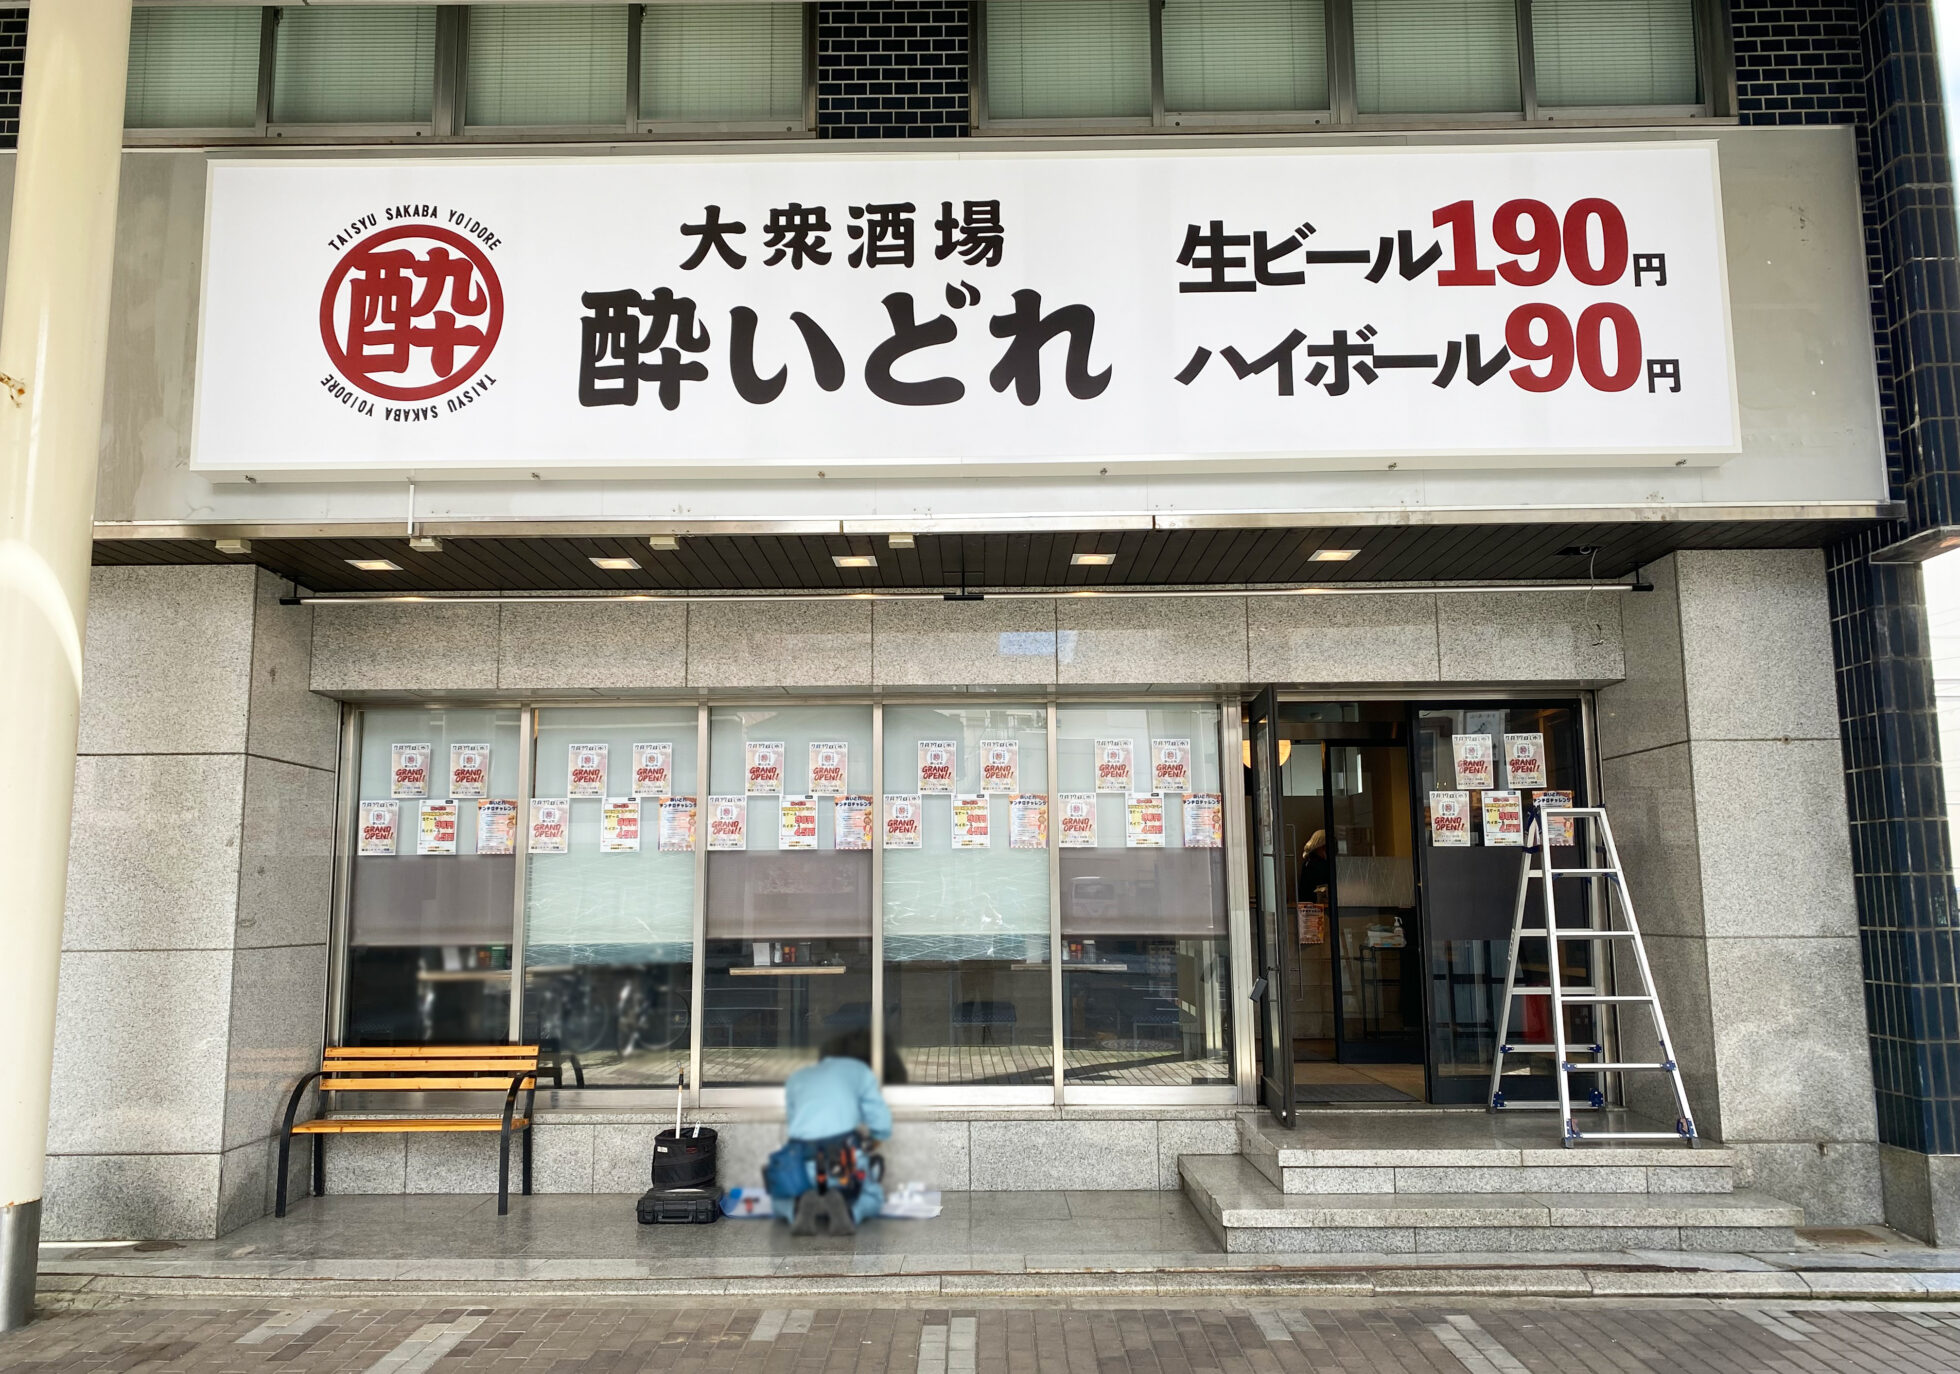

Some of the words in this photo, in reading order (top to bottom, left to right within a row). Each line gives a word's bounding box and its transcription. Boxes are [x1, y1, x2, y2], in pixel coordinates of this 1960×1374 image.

[328, 213, 377, 251] TAISYU
[386, 204, 438, 221] SAKABA
[448, 209, 502, 251] YOIDORE
[679, 199, 1005, 271] 大衆酒場
[1176, 197, 1668, 294] 生ビール190円
[346, 246, 488, 378] 酔
[578, 279, 1113, 411] 酔いどれ
[1174, 301, 1682, 397] ハイボール90円
[320, 374, 374, 417] YOIDORE
[448, 374, 496, 413] TAISYU
[385, 405, 438, 422] SAKABA
[1457, 759, 1484, 767] GRAND
[1509, 758, 1537, 766] GRAND
[636, 767, 664, 775] GRAND
[749, 766, 777, 774] GRAND
[813, 766, 840, 774] GRAND
[921, 765, 949, 773] GRAND
[984, 764, 1011, 772] GRAND
[1099, 763, 1126, 771] GRAND
[1156, 763, 1183, 771] GRAND
[1510, 764, 1540, 772] OPEN!!
[396, 768, 423, 776] GRAND
[454, 768, 482, 776] GRAND
[572, 768, 600, 776] GRAND
[750, 772, 779, 780] OPEN!!
[922, 771, 951, 779] OPEN!!
[985, 770, 1014, 779] OPEN!!
[1100, 769, 1129, 778] OPEN!!
[1157, 769, 1186, 778] OPEN!!
[397, 774, 425, 782] OPEN!!
[455, 774, 484, 783] OPEN!!
[573, 774, 602, 783] OPEN!!
[813, 773, 842, 781] OPEN!!
[711, 820, 739, 828] GRAND
[887, 818, 914, 826] GRAND
[1062, 817, 1089, 825] GRAND
[1434, 816, 1461, 824] GRAND
[363, 825, 391, 833] GRAND
[533, 823, 561, 831] GRAND
[712, 826, 741, 834] OPEN!!
[888, 825, 917, 833] OPEN!!
[1063, 823, 1092, 832] OPEN!!
[1435, 822, 1464, 831] OPEN!!
[364, 831, 393, 840] OPEN!!
[534, 829, 563, 838] OPEN!!
